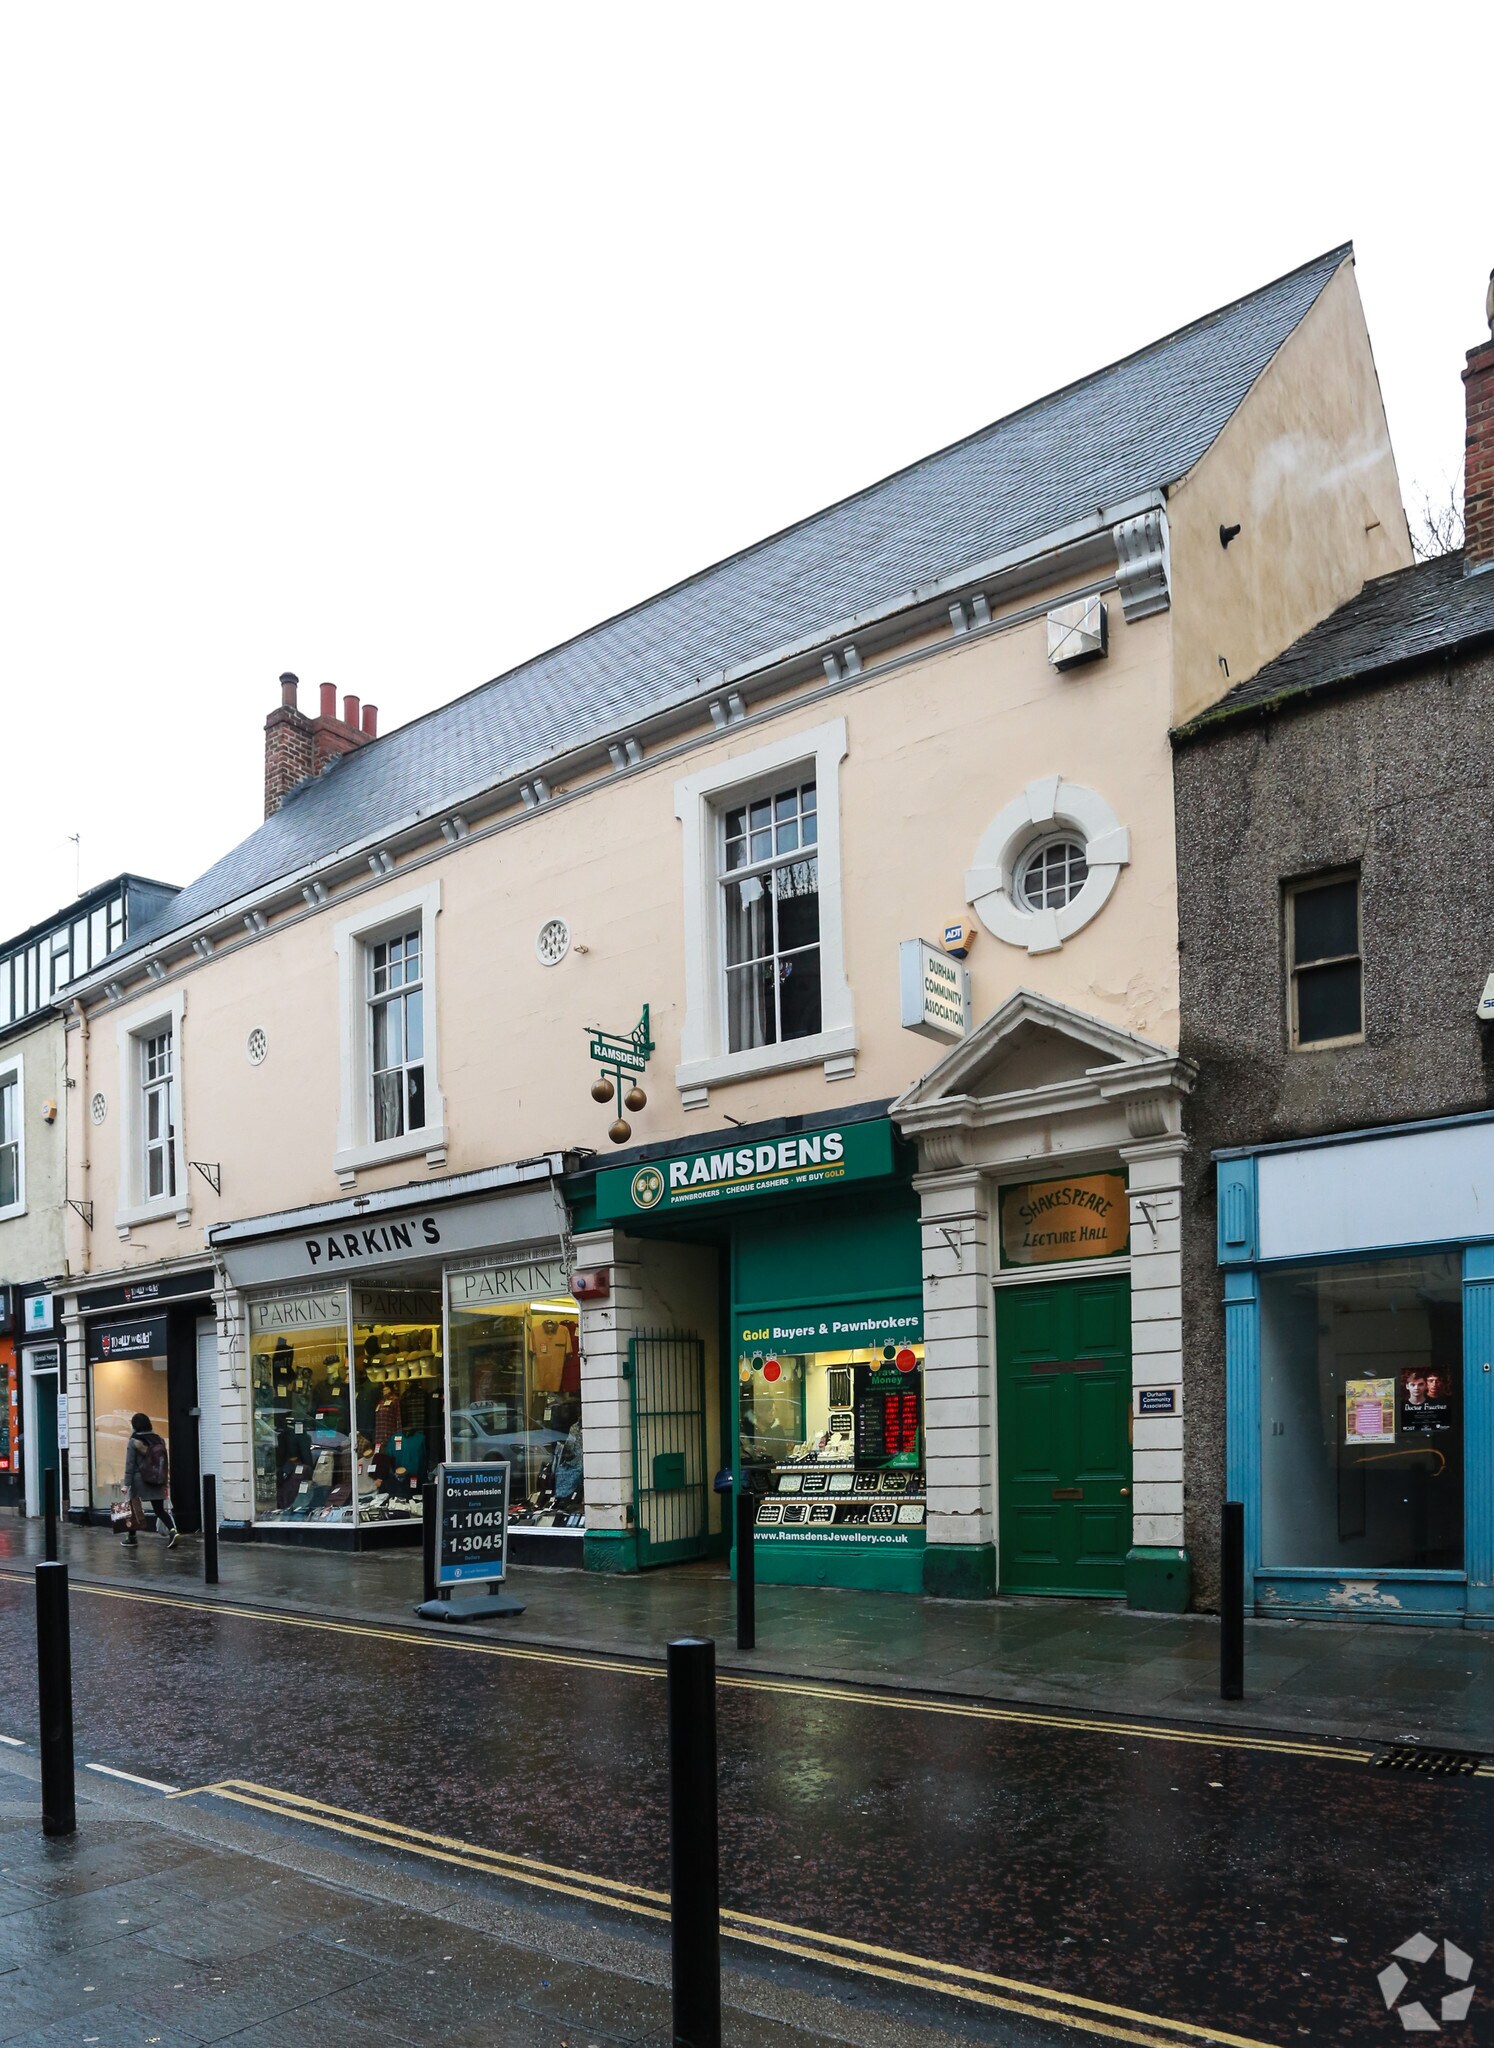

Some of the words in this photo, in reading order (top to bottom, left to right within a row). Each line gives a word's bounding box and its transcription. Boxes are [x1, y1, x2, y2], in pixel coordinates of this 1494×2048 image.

[945, 928, 962, 940] ADT
[929, 958, 956, 984] DURHAM
[924, 977, 961, 1006] COMMUNITY
[924, 998, 964, 1027] ASSOCIATION
[594, 1044, 645, 1067] RAMSDENS
[669, 1132, 844, 1188] RAMSDENS
[670, 1189, 720, 1203] PAWNBROKERS
[726, 1183, 755, 1194] CHEQUE
[756, 1177, 789, 1189] CASHERS
[795, 1174, 808, 1183] WE
[808, 1172, 824, 1181] BUY
[824, 1169, 845, 1178] GOLD
[1019, 1187, 1113, 1225] SHAKESPEARE
[305, 1217, 441, 1265] PARKIN'S
[1023, 1230, 1076, 1248] LECTURE
[1079, 1226, 1108, 1241] HALL
[742, 1328, 769, 1341] Gold
[773, 1326, 815, 1340] Buyers
[818, 1324, 829, 1335] &
[832, 1316, 919, 1333] Pawnbrokers
[871, 1377, 903, 1385] Money
[446, 1475, 473, 1485] Travel
[475, 1474, 503, 1484] Money
[446, 1488, 461, 1497] 0%
[463, 1488, 501, 1497] Commission
[450, 1511, 502, 1529] 1.1043
[450, 1534, 502, 1553] 1.3045
[753, 1531, 908, 1543] www.RamsdensJewellery.co.uk
